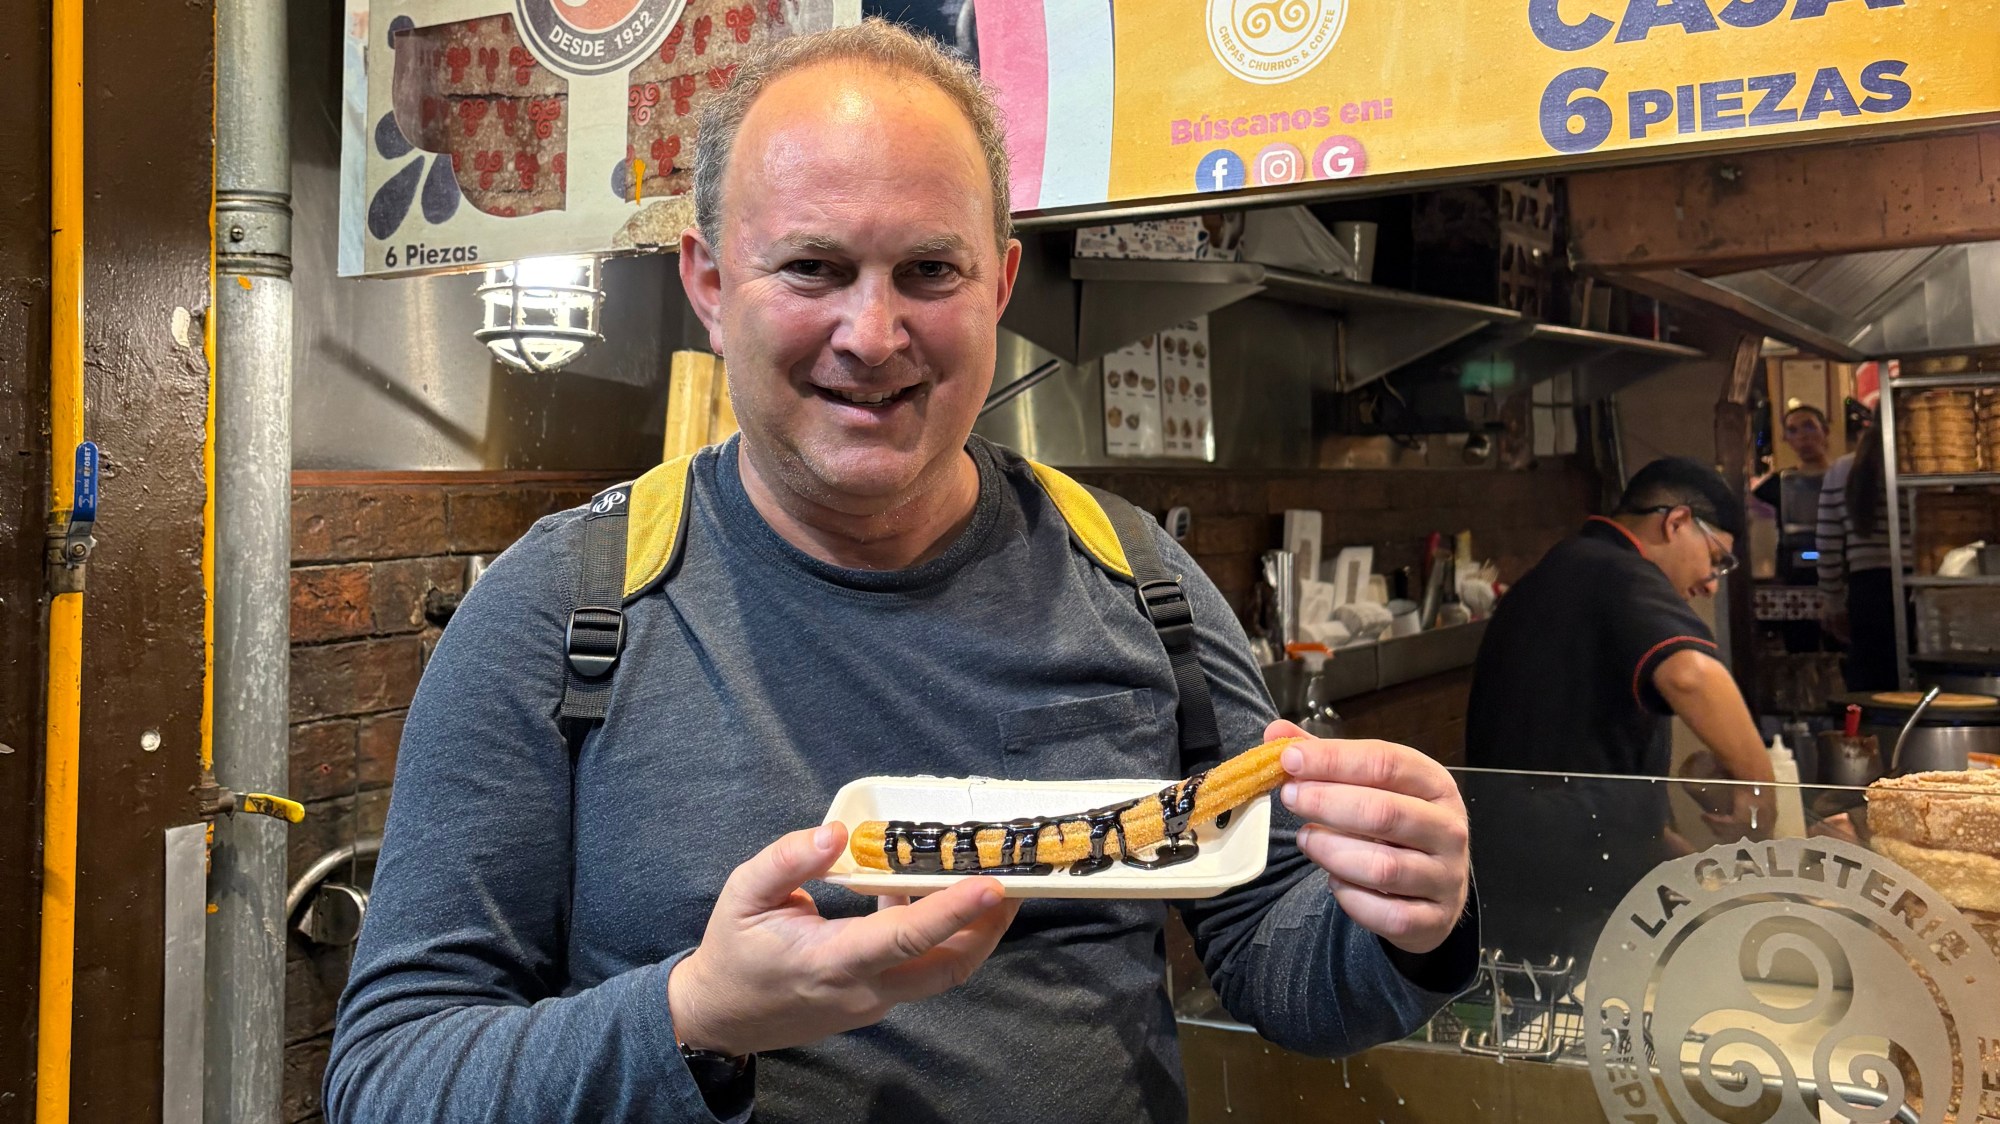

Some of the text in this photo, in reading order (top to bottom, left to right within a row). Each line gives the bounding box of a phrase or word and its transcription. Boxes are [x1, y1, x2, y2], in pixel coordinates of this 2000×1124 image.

[549, 11, 655, 57] DESDE 1932
[1219, 9, 1336, 72] CREPAS, CHURROS & COFFEE
[1171, 98, 1394, 146] Búscanos en:
[1539, 59, 1912, 154] 6 PIEZAS
[385, 243, 478, 268] 6 Piezas
[1630, 884, 1692, 938] LA
